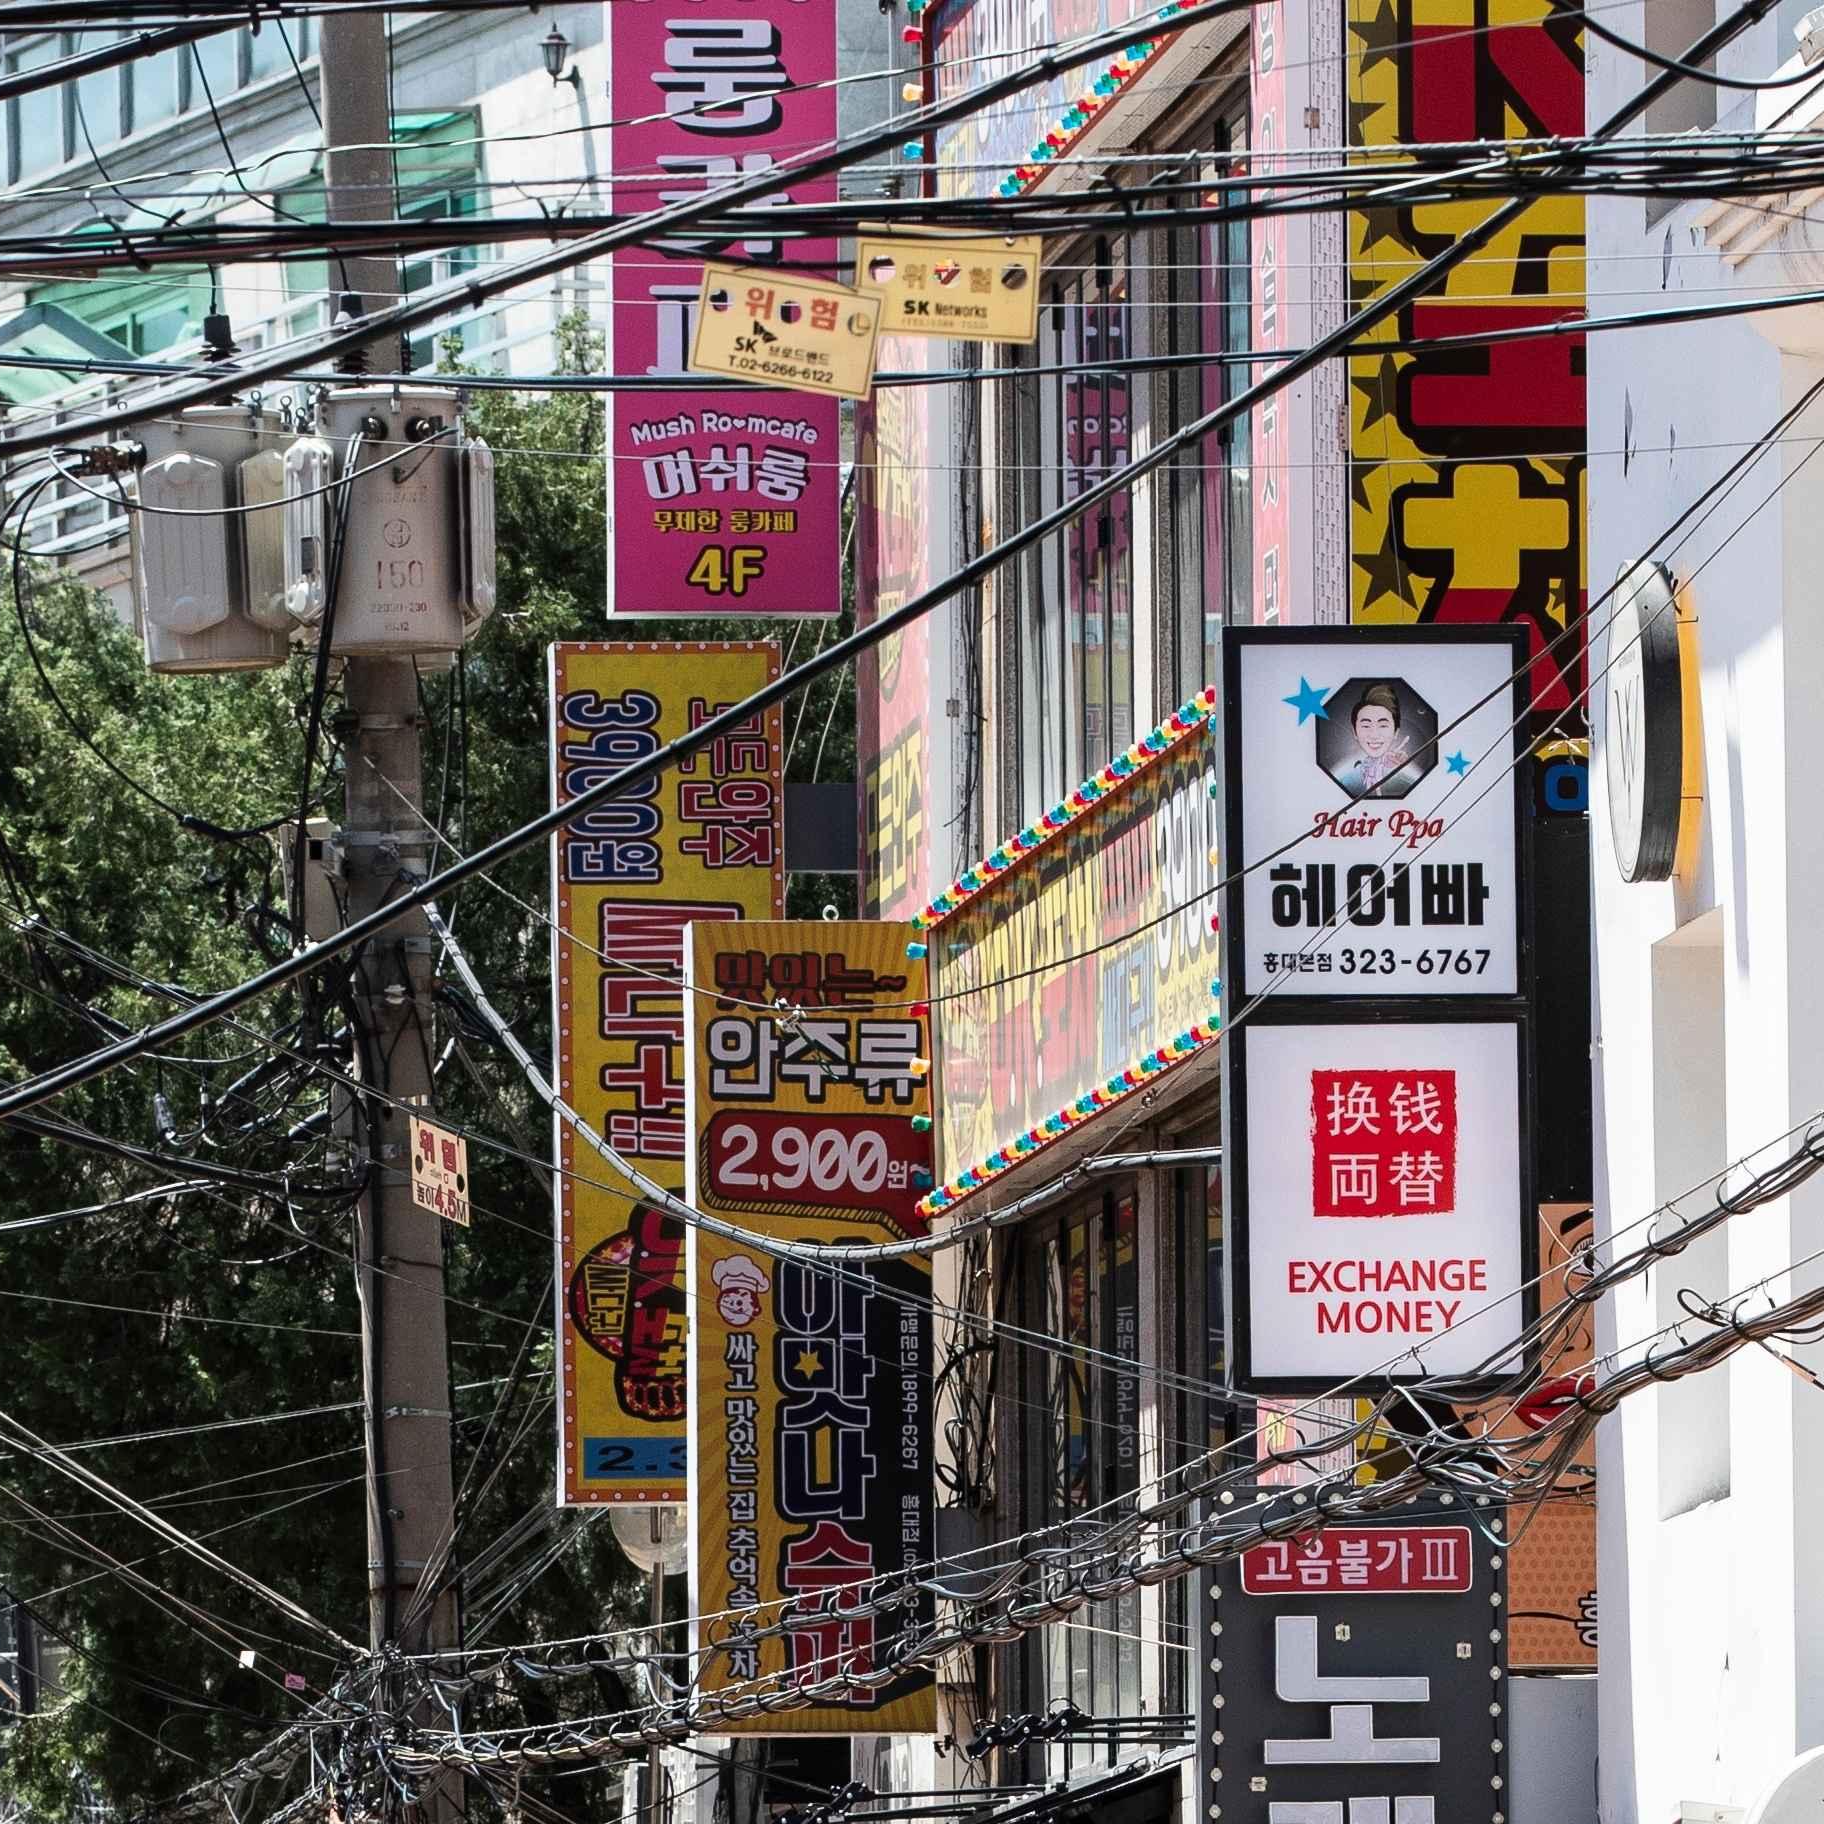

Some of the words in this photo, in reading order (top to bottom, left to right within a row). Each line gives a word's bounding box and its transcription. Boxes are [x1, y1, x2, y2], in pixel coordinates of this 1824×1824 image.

[903, 299, 930, 316] SK
[734, 336, 758, 354] SK
[630, 414, 695, 447] Mush
[641, 445, 811, 503] 머쉬룸
[687, 546, 768, 594] 4F
[1311, 809, 1382, 842] Hair
[1387, 808, 1446, 849] Ppa
[1269, 861, 1490, 928] 헤어빠
[1339, 948, 1491, 976] 323-6767
[710, 1017, 926, 1103] 안주류
[1327, 1079, 1444, 1137] 换钱
[1287, 1258, 1488, 1294] EXCHANGE
[1316, 1299, 1463, 1335] MONEY
[724, 1334, 759, 1392] 싸고
[724, 1398, 760, 1485] 맛있는
[727, 1492, 758, 1522] 집
[1255, 1531, 1416, 1586] 고음불가
